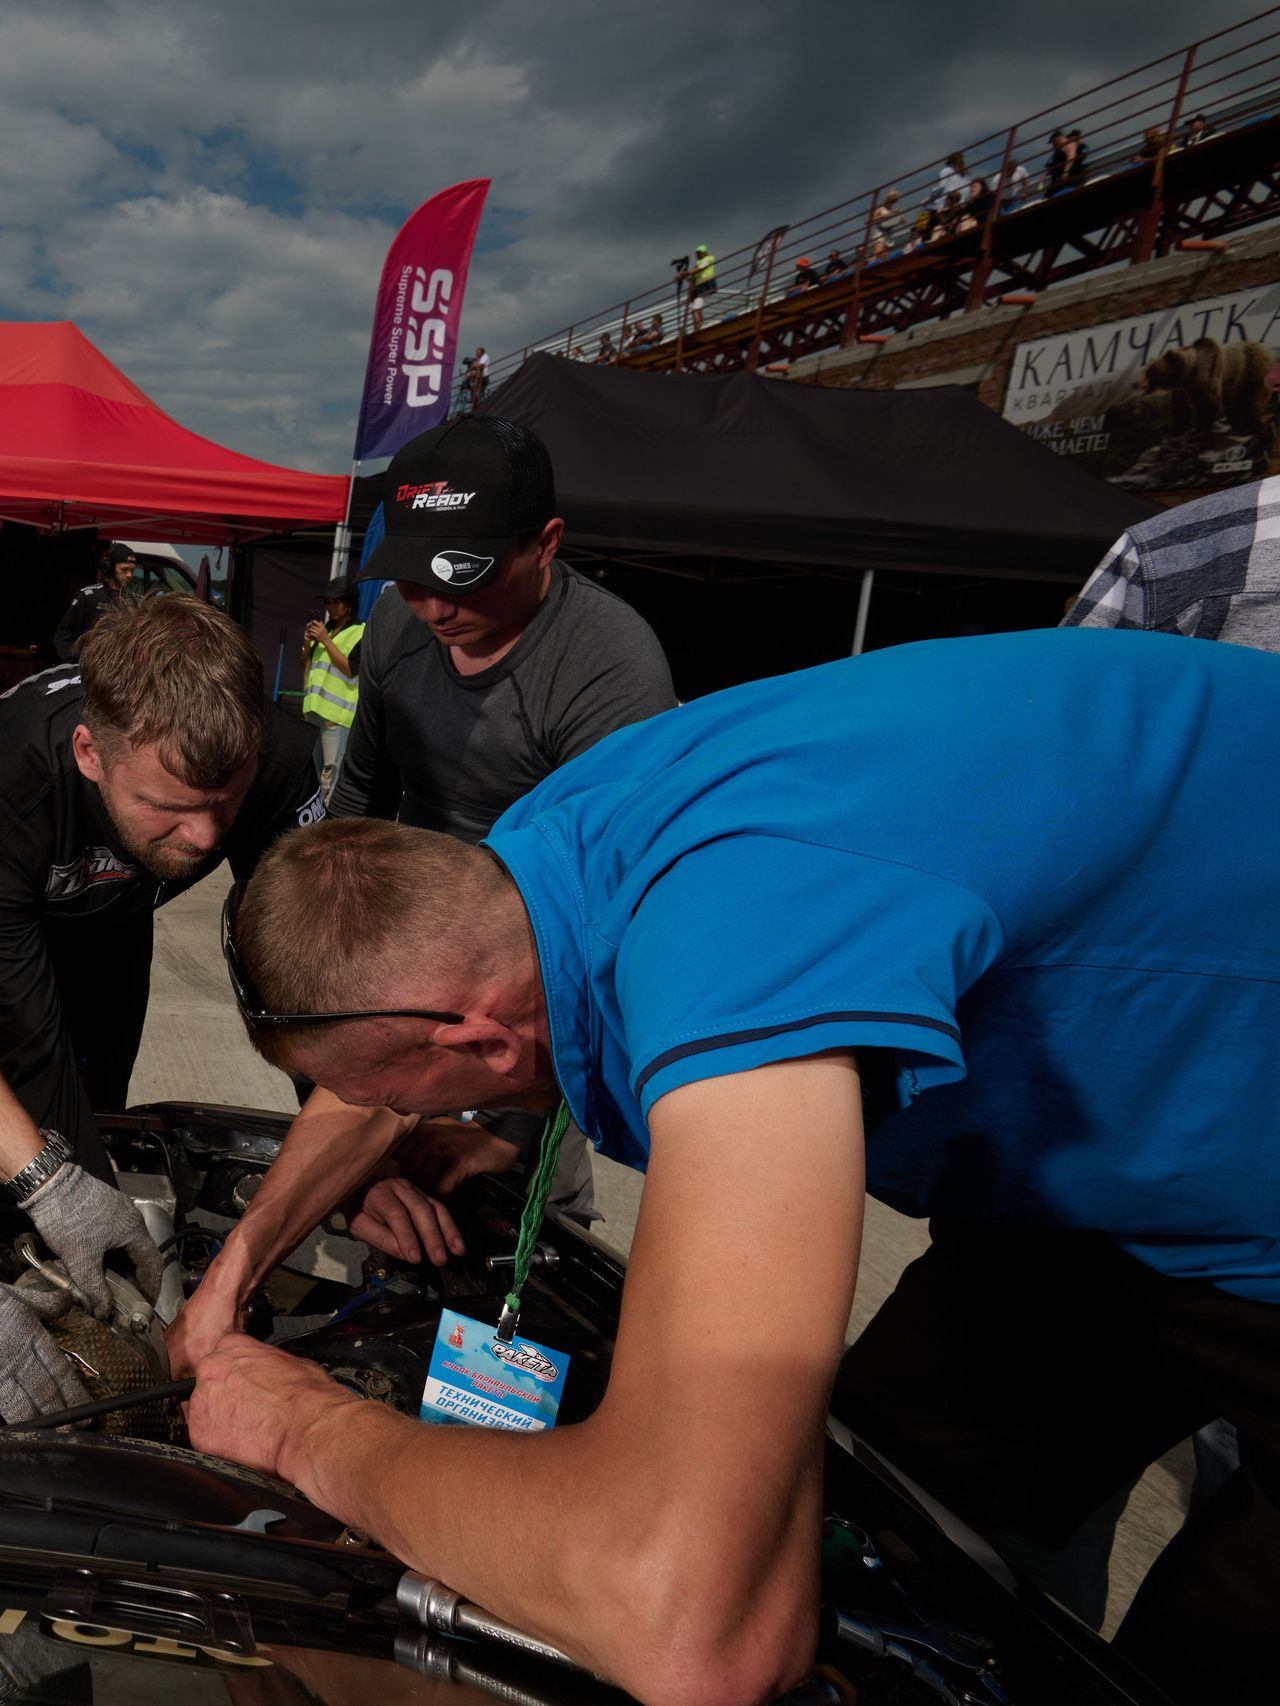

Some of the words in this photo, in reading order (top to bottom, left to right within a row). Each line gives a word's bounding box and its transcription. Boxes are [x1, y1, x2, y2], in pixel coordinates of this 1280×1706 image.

[395, 265, 413, 325] Supreme
[388, 326, 403, 366] Super
[402, 266, 453, 408] SSP
[383, 367, 398, 406] Power
[491, 1343, 559, 1378] РАКЕТА
[441, 1360, 470, 1377] КУБОК
[471, 1372, 542, 1403] БАРНАУЛЬСКОЙ
[471, 1381, 507, 1399] РАКЕТЫ
[439, 1385, 533, 1429] ТЕХНИЧЕСКИЙ
